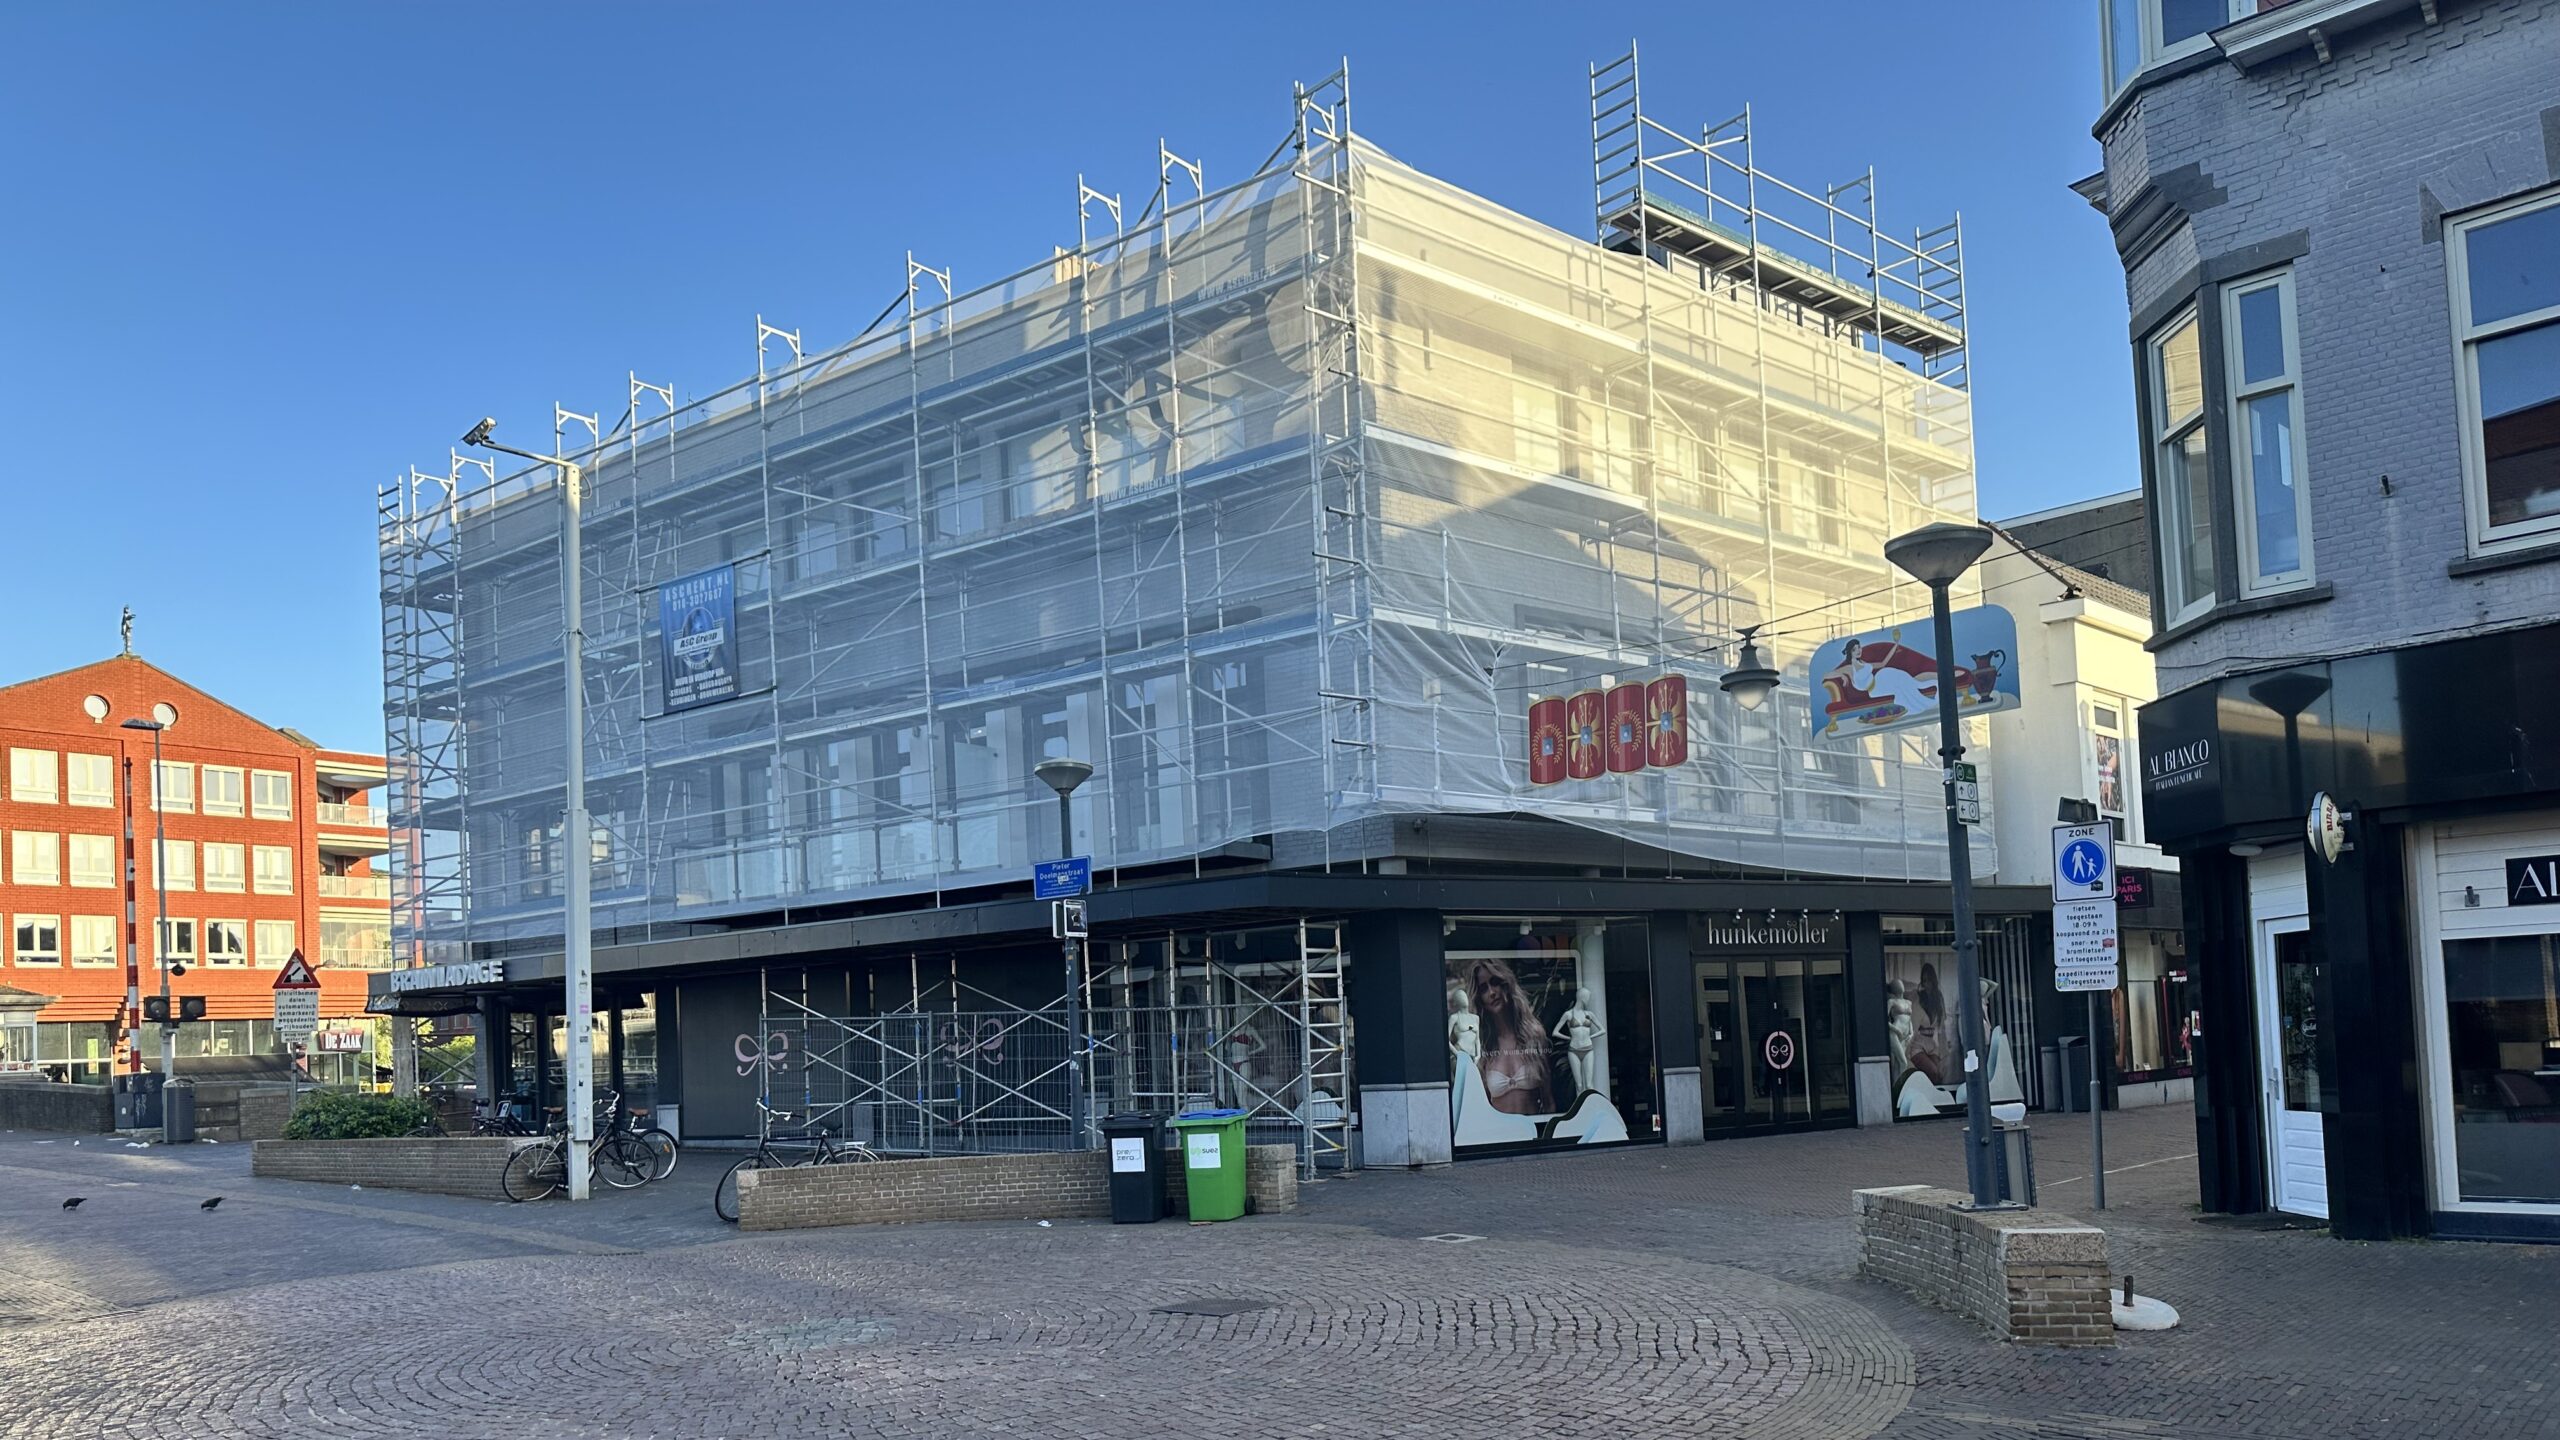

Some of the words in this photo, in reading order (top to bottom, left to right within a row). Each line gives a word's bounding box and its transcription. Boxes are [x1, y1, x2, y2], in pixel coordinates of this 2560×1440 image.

[2149, 755, 2161, 777] AL
[2164, 739, 2209, 772] BIANCO
[2068, 828, 2095, 838] ZONE
[1051, 863, 1071, 871] Pieter
[2121, 876, 2135, 884] ICI
[2116, 884, 2143, 894] PARIS
[2123, 895, 2136, 903] XL
[2066, 913, 2103, 921] toegestaan
[1708, 918, 1829, 944] hunkemöller
[2056, 929, 2090, 938] koopavond
[2066, 947, 2106, 955] bromfietsen
[2075, 955, 2112, 964] toegestaan
[2057, 970, 2115, 978] expeditieverkeer
[2068, 978, 2106, 987] toegestaan
[339, 1033, 362, 1049] ZAAK
